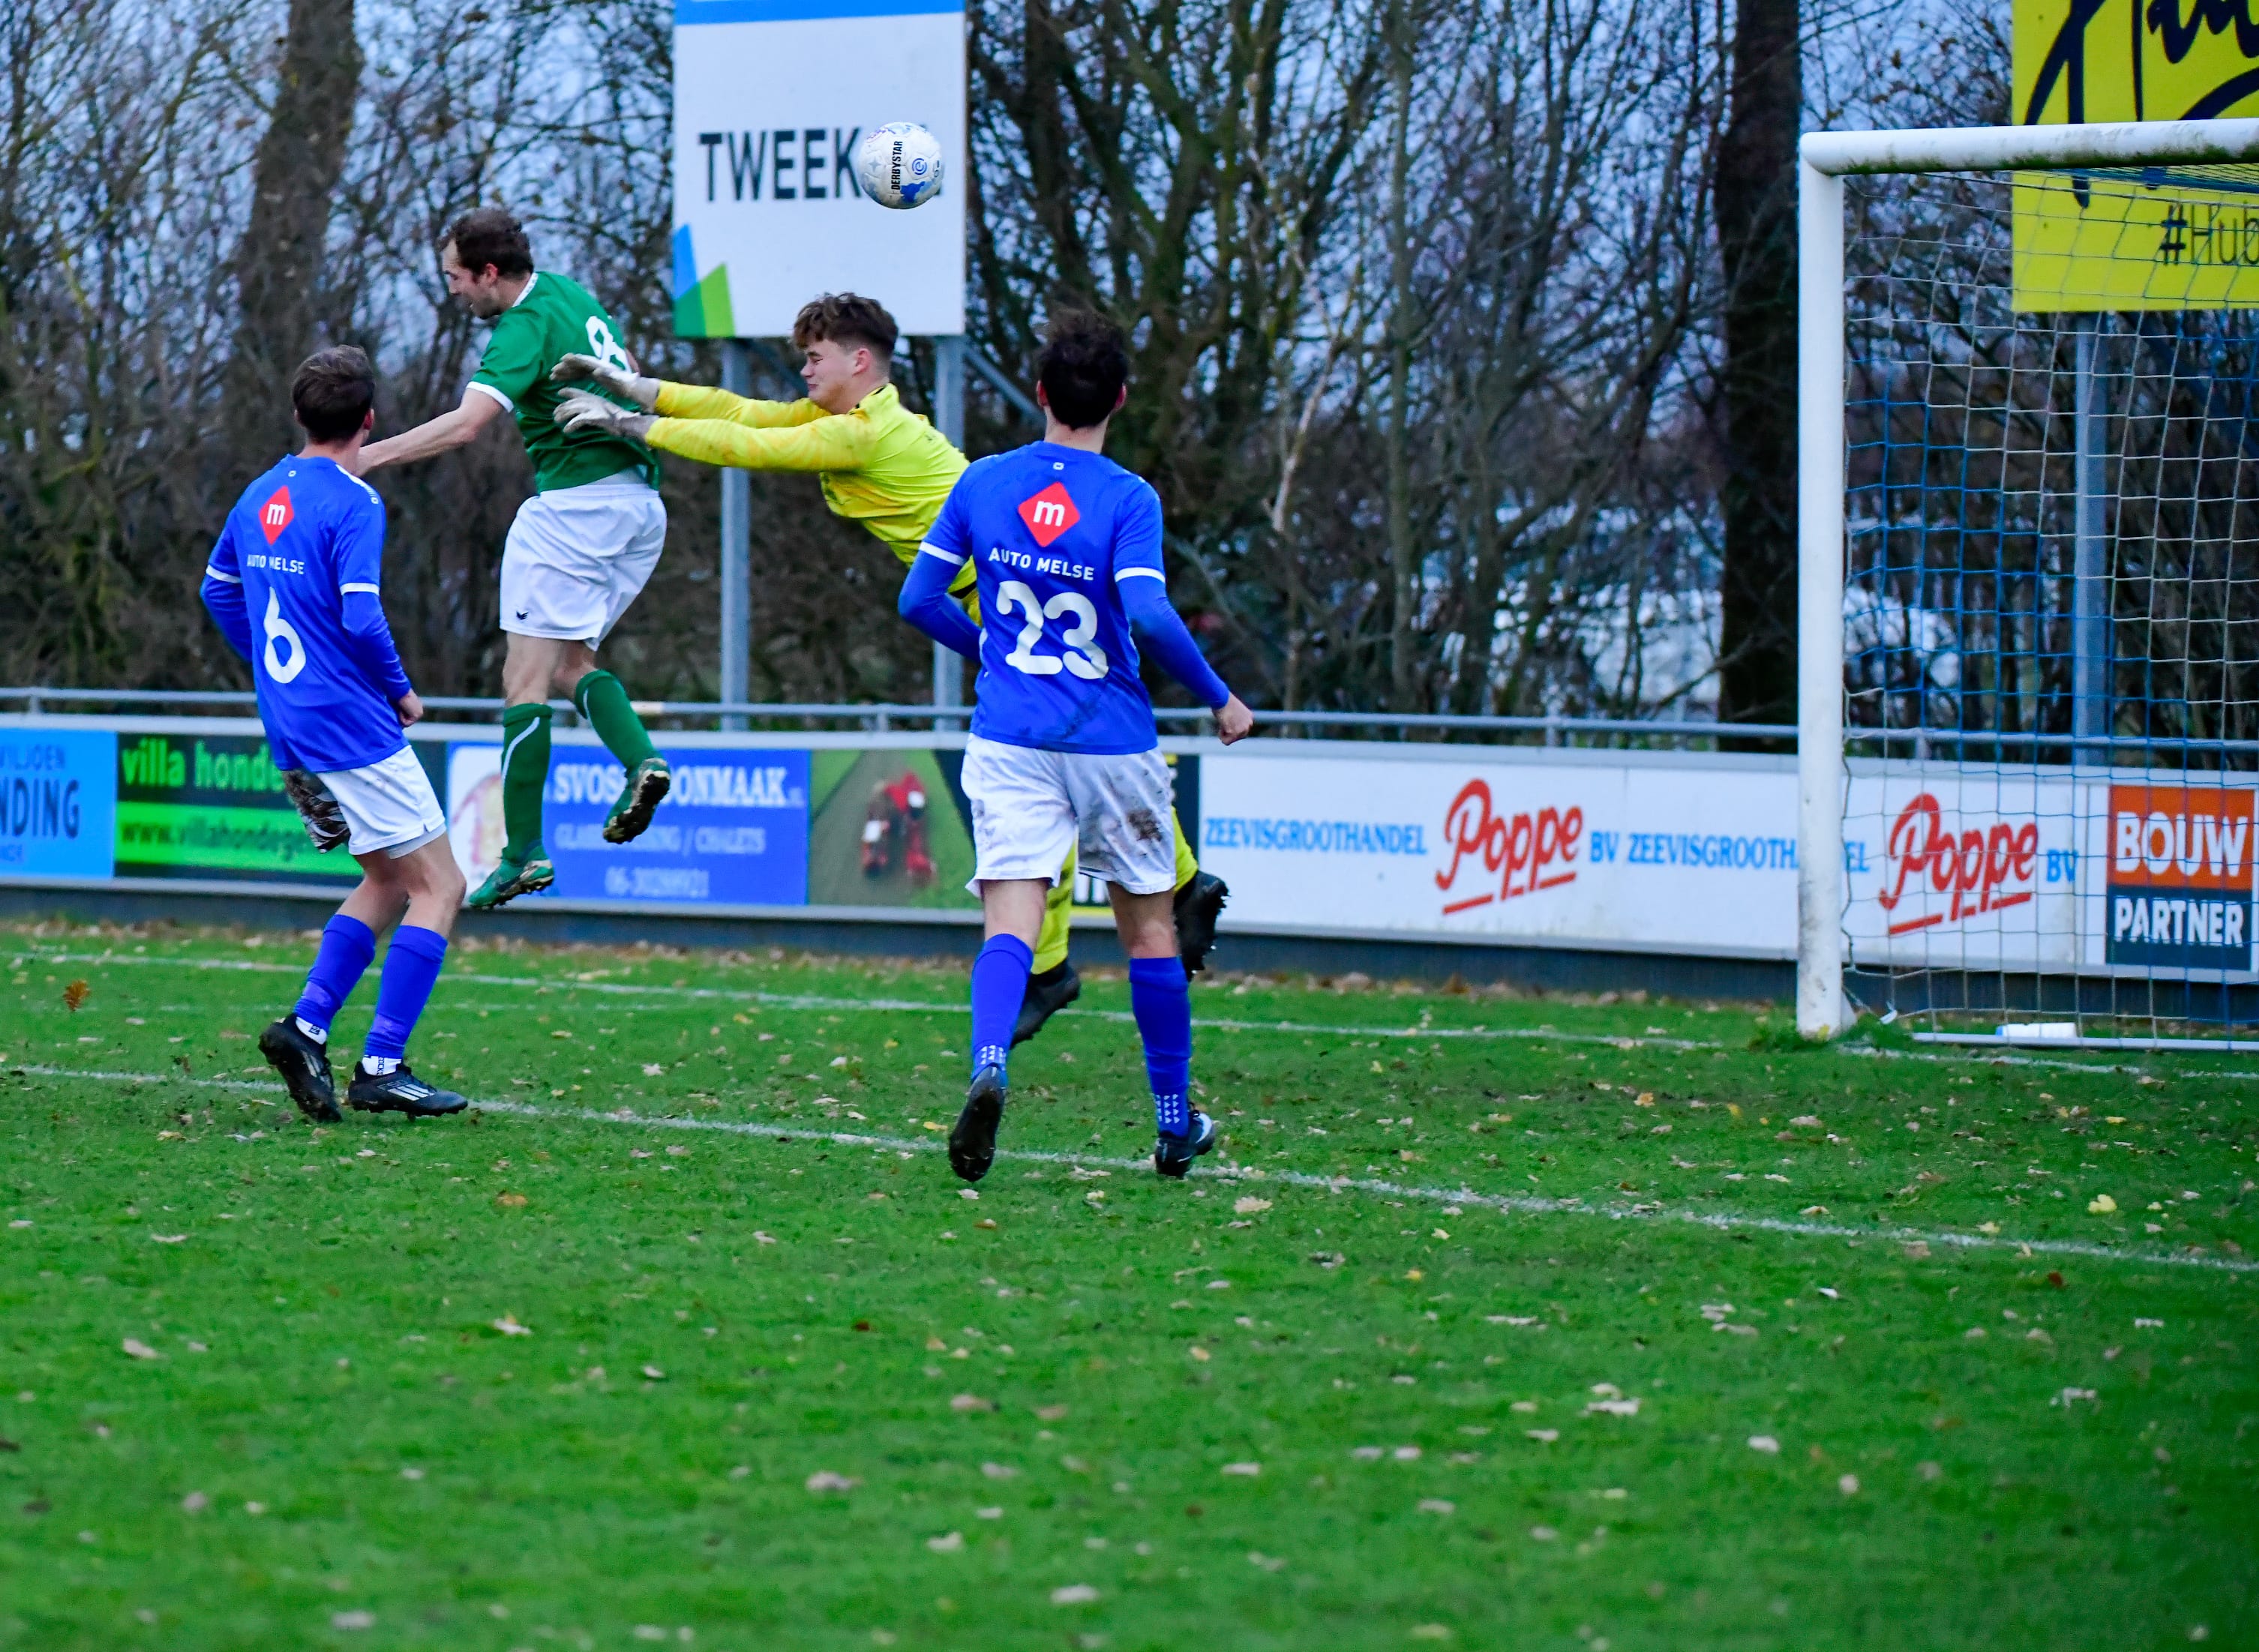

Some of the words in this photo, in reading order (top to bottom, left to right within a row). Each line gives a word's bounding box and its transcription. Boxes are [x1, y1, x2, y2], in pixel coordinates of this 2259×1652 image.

[698, 124, 942, 202] TWEEK
[890, 140, 903, 190] DERBYSTAR
[585, 316, 632, 374] 8
[266, 503, 286, 526] m
[1033, 500, 1065, 527] m
[247, 553, 267, 568] AUTO
[268, 556, 304, 575] MELSE
[988, 547, 1032, 569] AUTO
[1035, 556, 1095, 581] MELSE
[262, 586, 307, 684] 6
[995, 580, 1109, 679] 23
[122, 738, 186, 786] villa
[1204, 817, 1429, 856] ZEEVISGROOTHANDEL
[1435, 778, 1583, 901] Poppe
[1589, 831, 1620, 863] BV
[1628, 832, 1870, 873] ZEEVISGROOTHEL
[1879, 793, 2038, 921] Poppe
[2046, 849, 2079, 882] BV
[2115, 811, 2248, 878] BOUW
[2114, 895, 2244, 948] PARTNER
